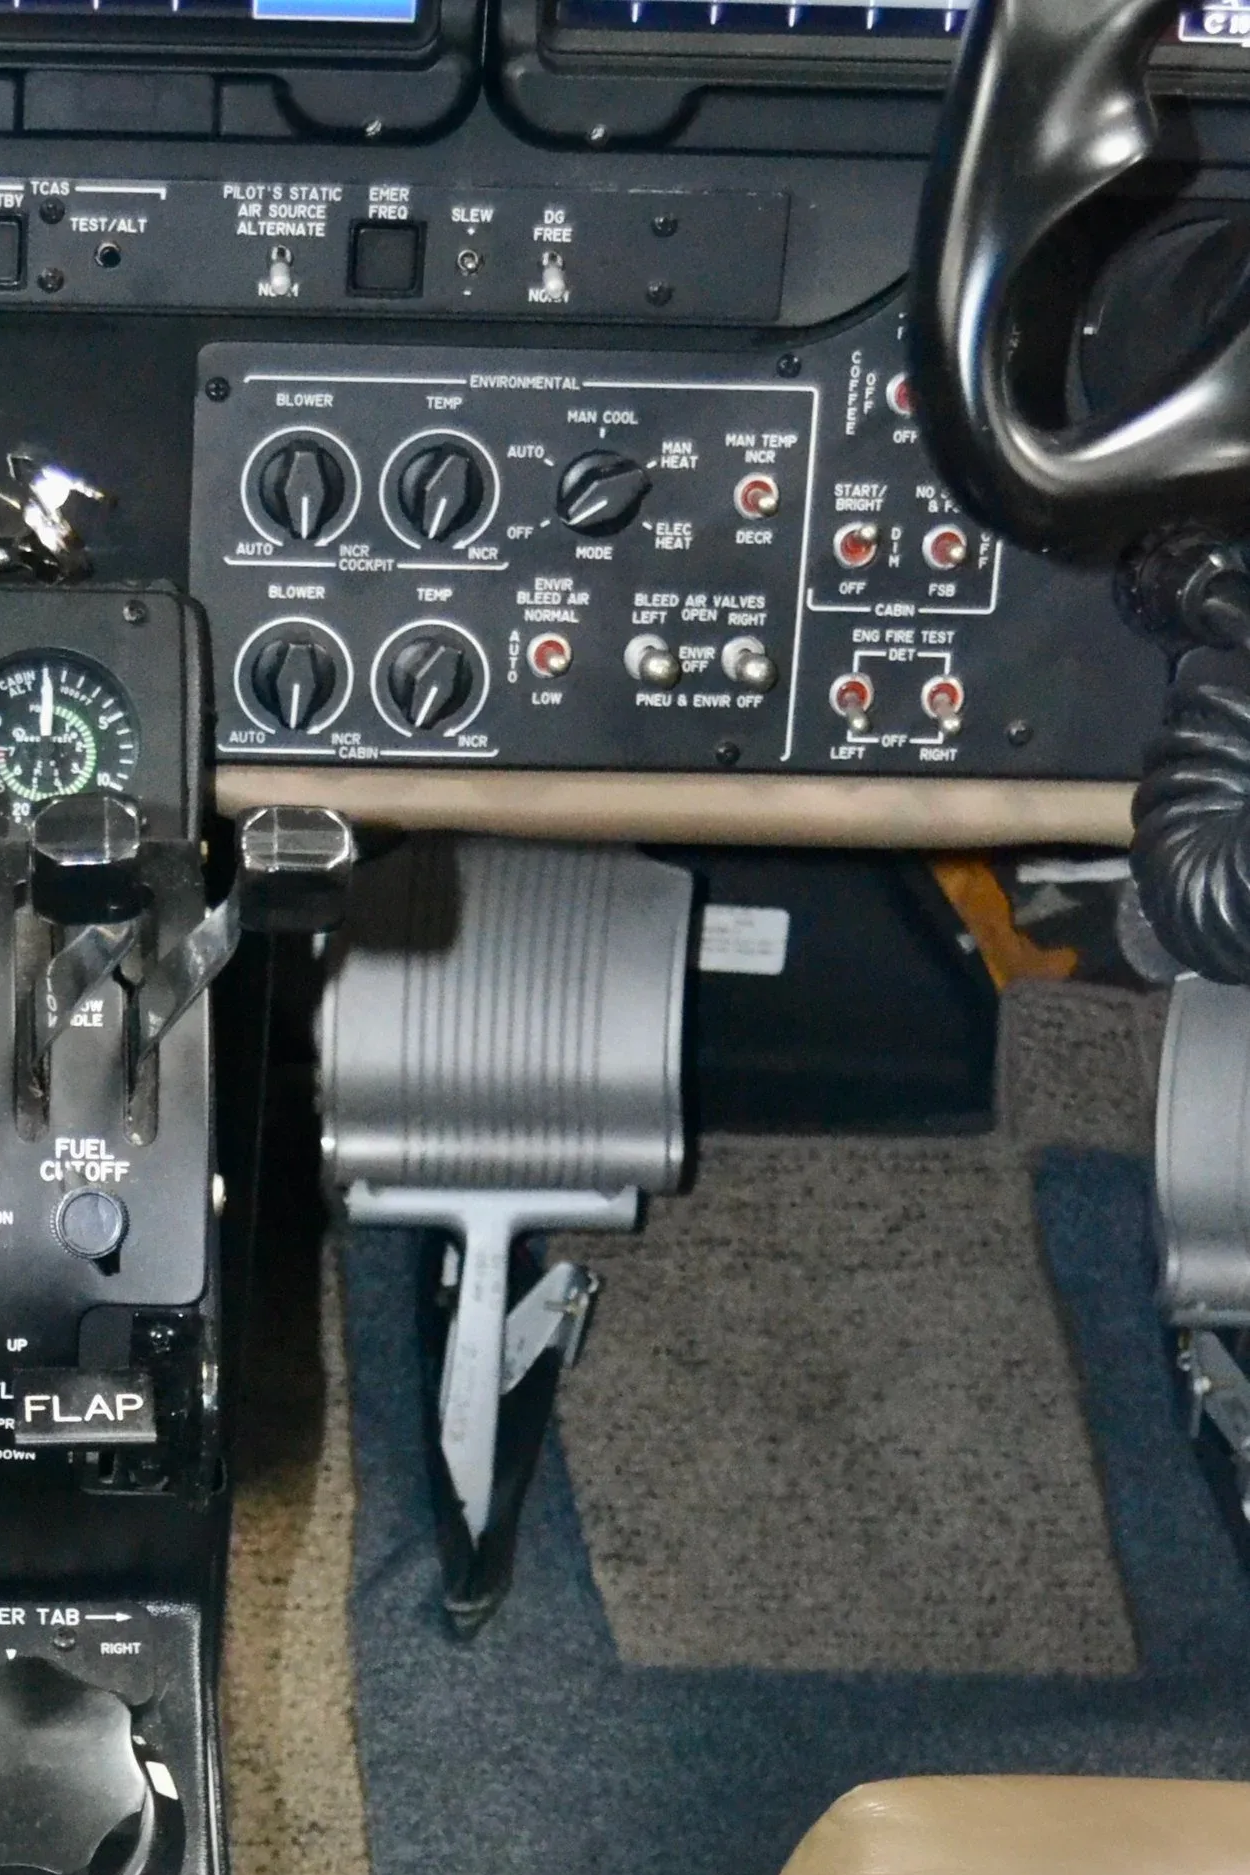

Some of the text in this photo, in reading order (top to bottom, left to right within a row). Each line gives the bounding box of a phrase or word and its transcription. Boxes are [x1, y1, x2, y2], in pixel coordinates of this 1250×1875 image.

[30, 182, 70, 195] TCAS
[223, 185, 342, 201] PILOT'S STATIC
[369, 187, 409, 201] EMER
[237, 204, 326, 220] AIR SOURCE
[452, 208, 493, 222] SLEW
[236, 222, 326, 237] ALTERNATE
[534, 228, 571, 242] FREE
[470, 375, 581, 390] ENVIRONMENTAL
[276, 394, 334, 407] BLOWER
[426, 396, 463, 410] TEMP
[568, 411, 638, 425] MAN COOL
[726, 434, 797, 448] MAN TEMP
[661, 456, 697, 469] HEAT
[835, 499, 883, 512] BRIGHT
[656, 523, 692, 536] ELEC
[655, 538, 692, 551] HEAT
[576, 547, 613, 560] MODE
[339, 559, 394, 572] COCKPIT
[268, 586, 325, 599] BLOWER
[417, 588, 453, 602] TEMP
[517, 592, 589, 606] BLEED AIR
[634, 594, 765, 609] BLEED AIR VALVES
[524, 610, 579, 624] NORMAL
[632, 611, 667, 624] LEFT
[728, 613, 767, 626] RIGHT
[853, 630, 955, 644] ENG FIRE TEST
[532, 692, 563, 705] LOW
[920, 748, 958, 761] RIGHT
[55, 1138, 115, 1159] FUEL
[7, 1339, 28, 1352] UP
[24, 1394, 144, 1422] FLAP
[36, 1608, 81, 1626] TAB
[101, 1642, 142, 1655] RIGHT
